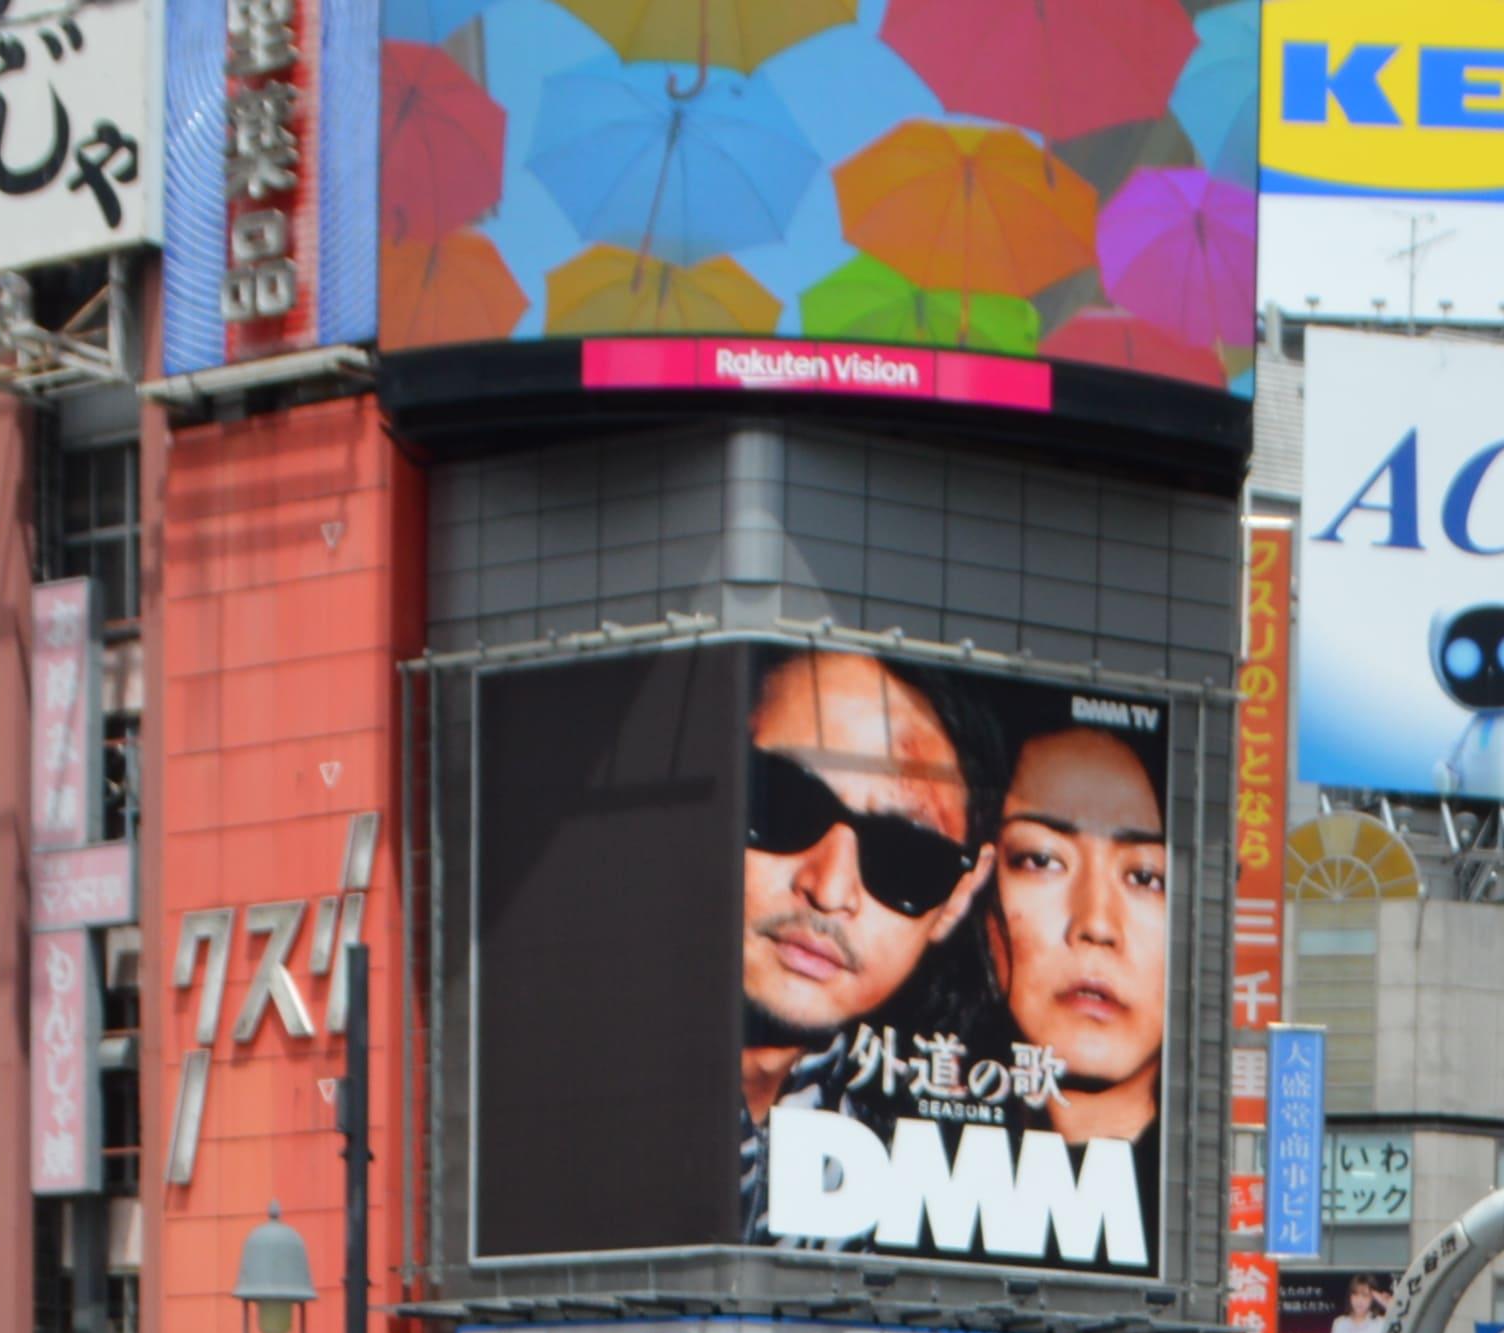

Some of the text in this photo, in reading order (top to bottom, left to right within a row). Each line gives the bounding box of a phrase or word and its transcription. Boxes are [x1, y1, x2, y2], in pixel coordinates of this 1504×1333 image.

[716, 348, 920, 388] Rakuten Vision
[1072, 697, 1160, 732] DMM TV
[1239, 540, 1279, 869] クスリのことなら
[164, 811, 380, 1187] クスリ
[847, 1022, 1072, 1109] 外道の歌
[919, 1098, 1004, 1122] SEASON 2
[1278, 1039, 1314, 1246] 大盛堂商事ビル
[768, 1105, 1149, 1268] DMM
[1338, 1143, 1410, 1173] いわ
